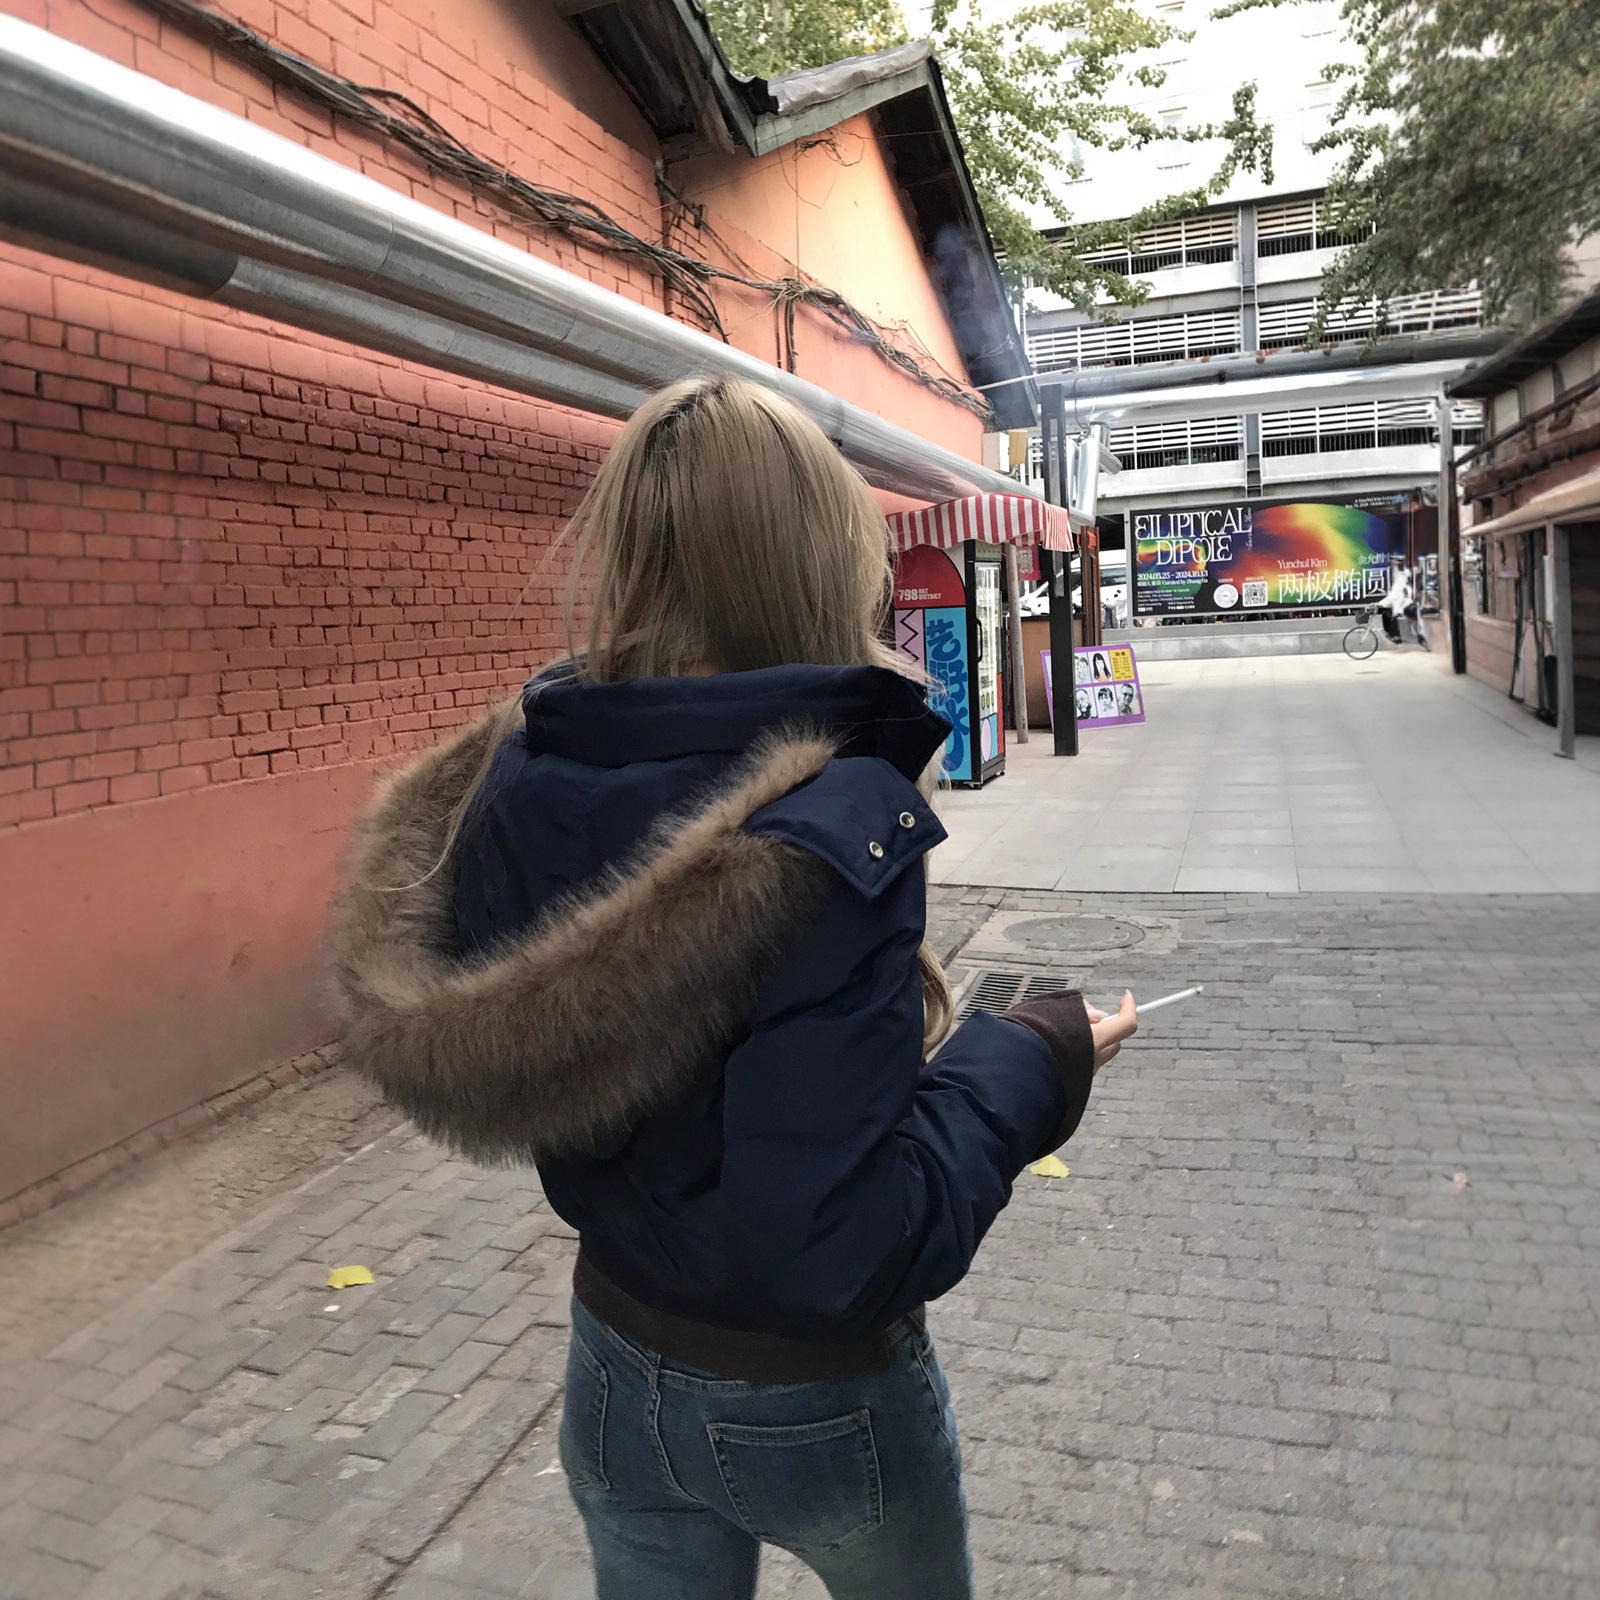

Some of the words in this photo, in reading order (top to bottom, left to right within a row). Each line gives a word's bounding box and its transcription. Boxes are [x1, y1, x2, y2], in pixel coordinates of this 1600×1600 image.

[1156, 535, 1232, 565] DIPOLE
[1278, 559, 1309, 569] Yunchul
[1311, 558, 1328, 568] Kim
[898, 588, 918, 601] 798
[1278, 566, 1391, 604] 两极椭圆
